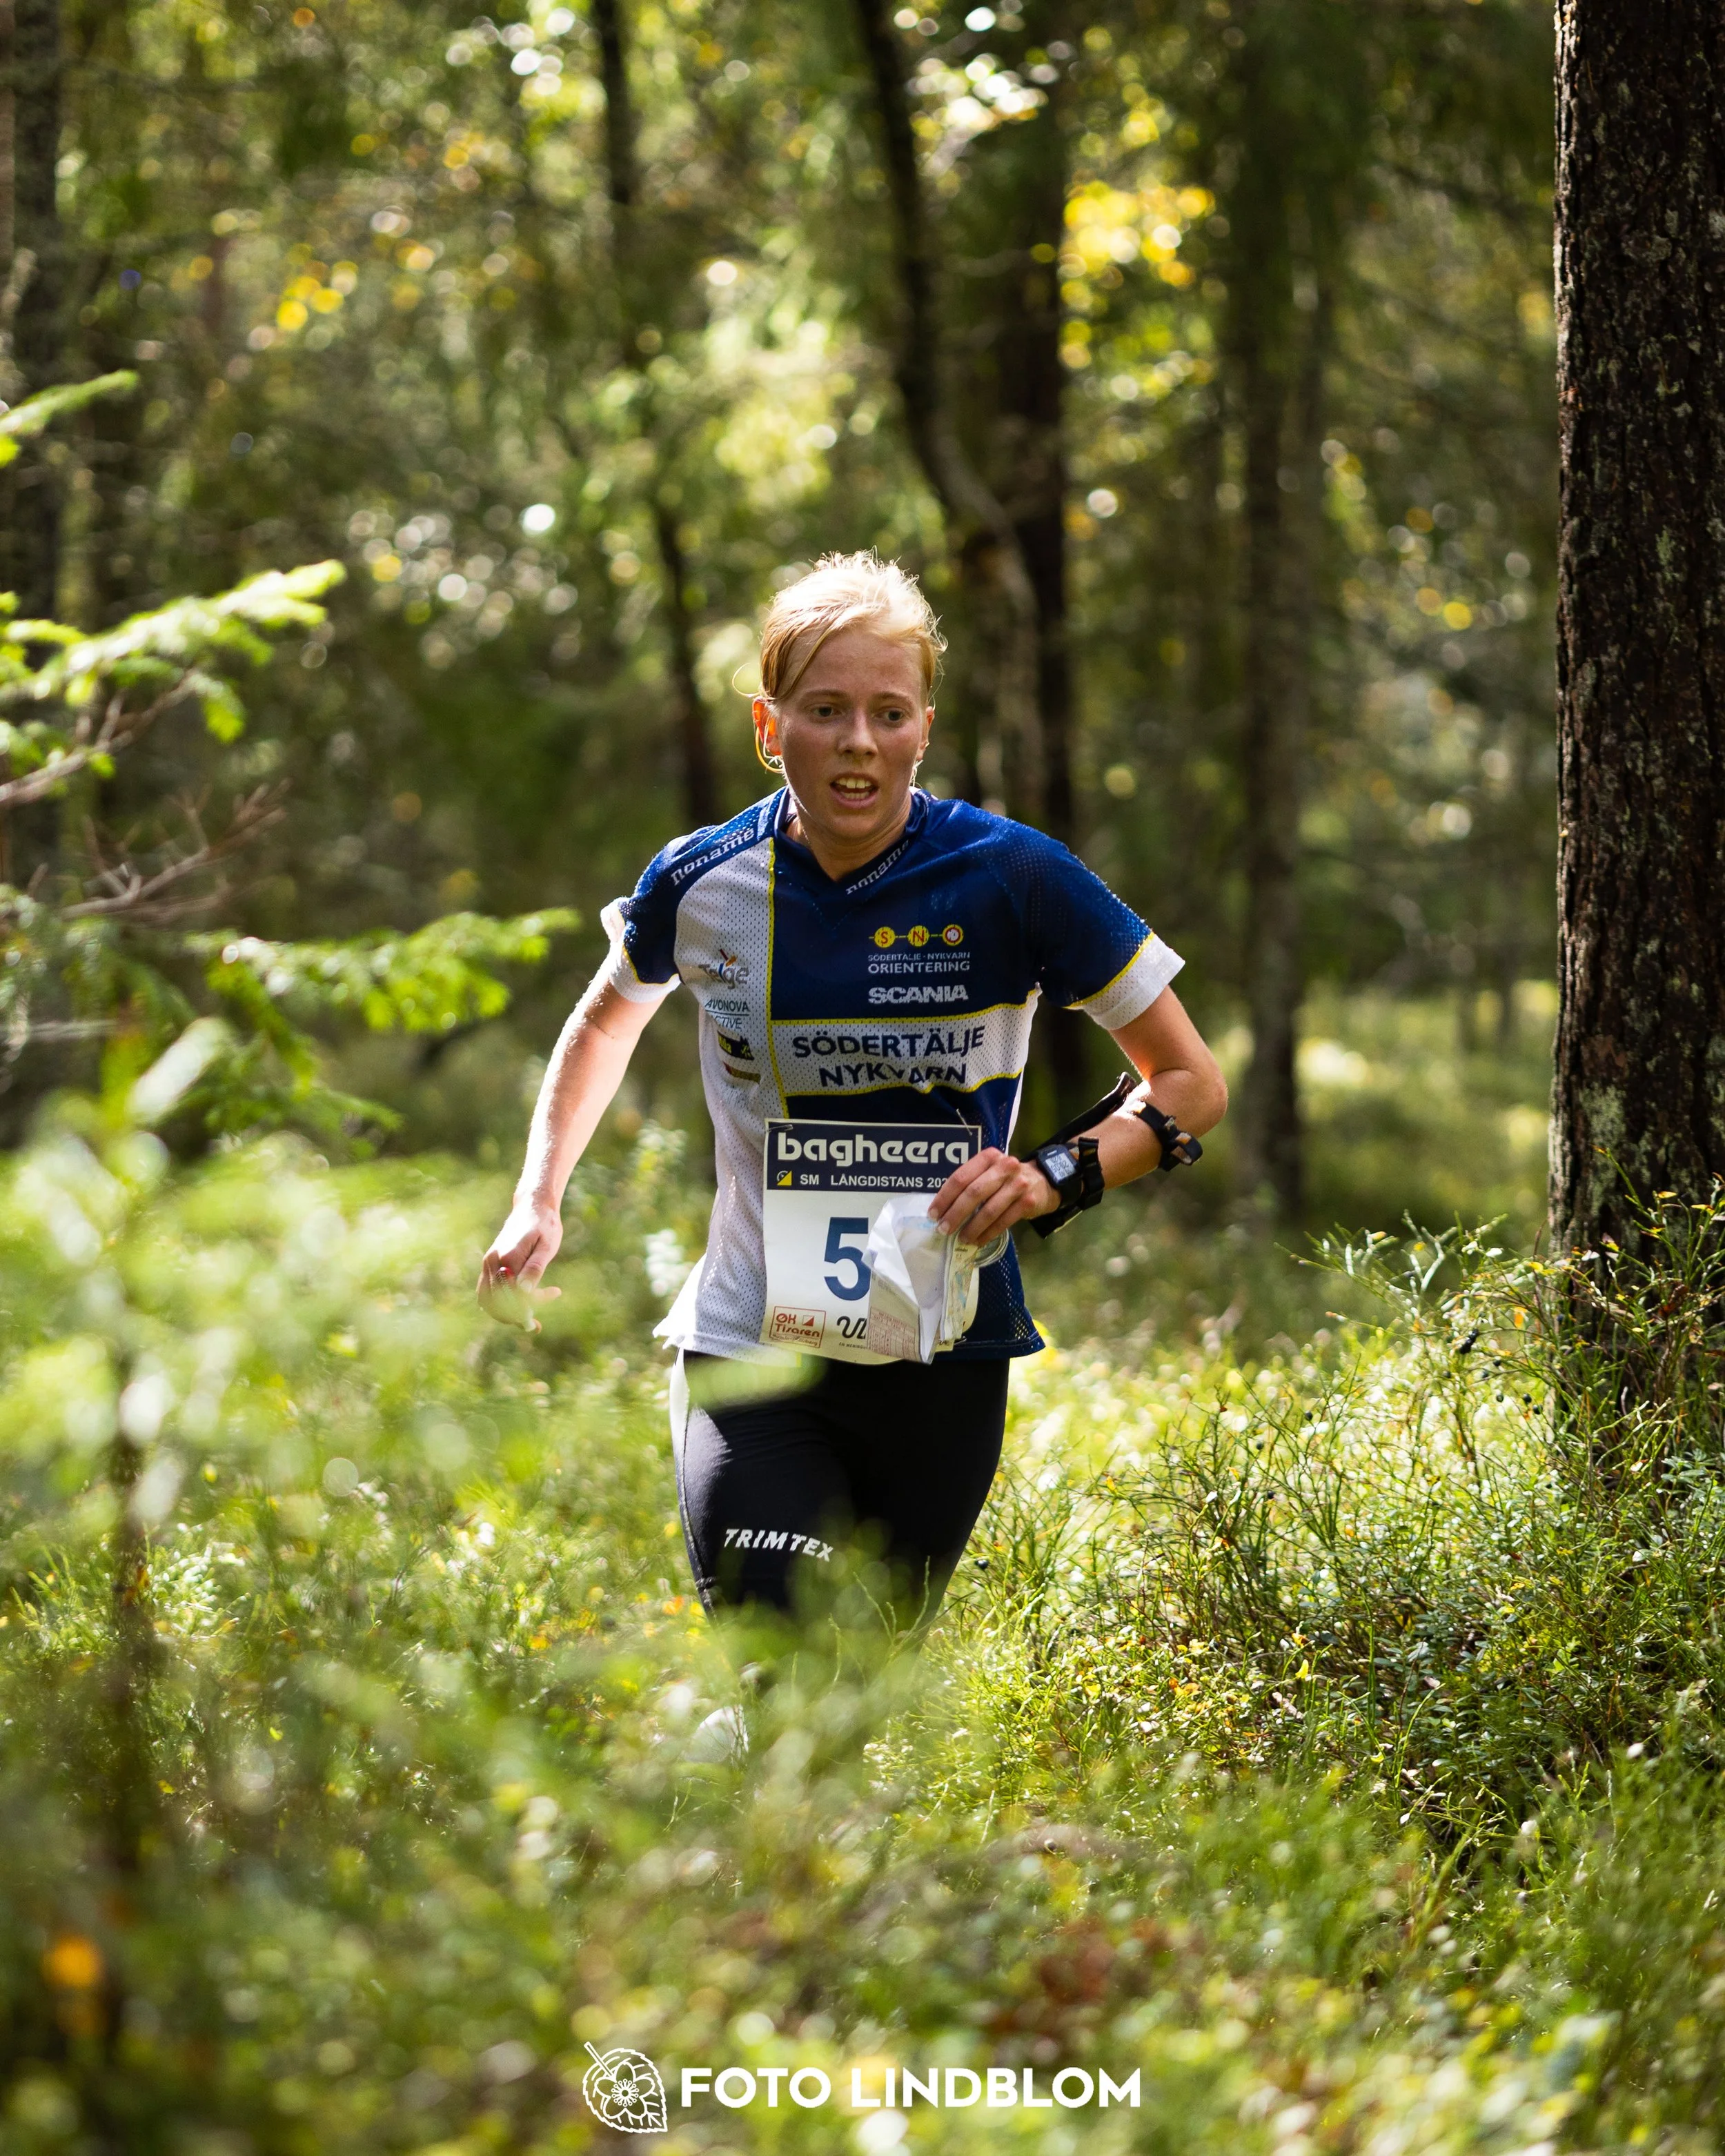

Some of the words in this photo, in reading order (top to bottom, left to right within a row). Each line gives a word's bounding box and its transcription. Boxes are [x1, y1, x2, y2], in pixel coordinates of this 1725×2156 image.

[671, 828, 754, 886] noname
[868, 961, 970, 974] ORIENTERING
[704, 998, 750, 1013] AVONOVA
[868, 985, 969, 1004] SCANIA
[793, 1025, 986, 1059] SÖDERTÄLJE
[818, 1062, 967, 1087] NYKVARN
[778, 1132, 969, 1167] bagheera
[800, 1174, 820, 1185] SM
[831, 1174, 923, 1188] LÅNGDISTANS
[824, 1216, 871, 1301] 5
[775, 1323, 821, 1338] Tisaren
[723, 1528, 834, 1561] TRIMTEX
